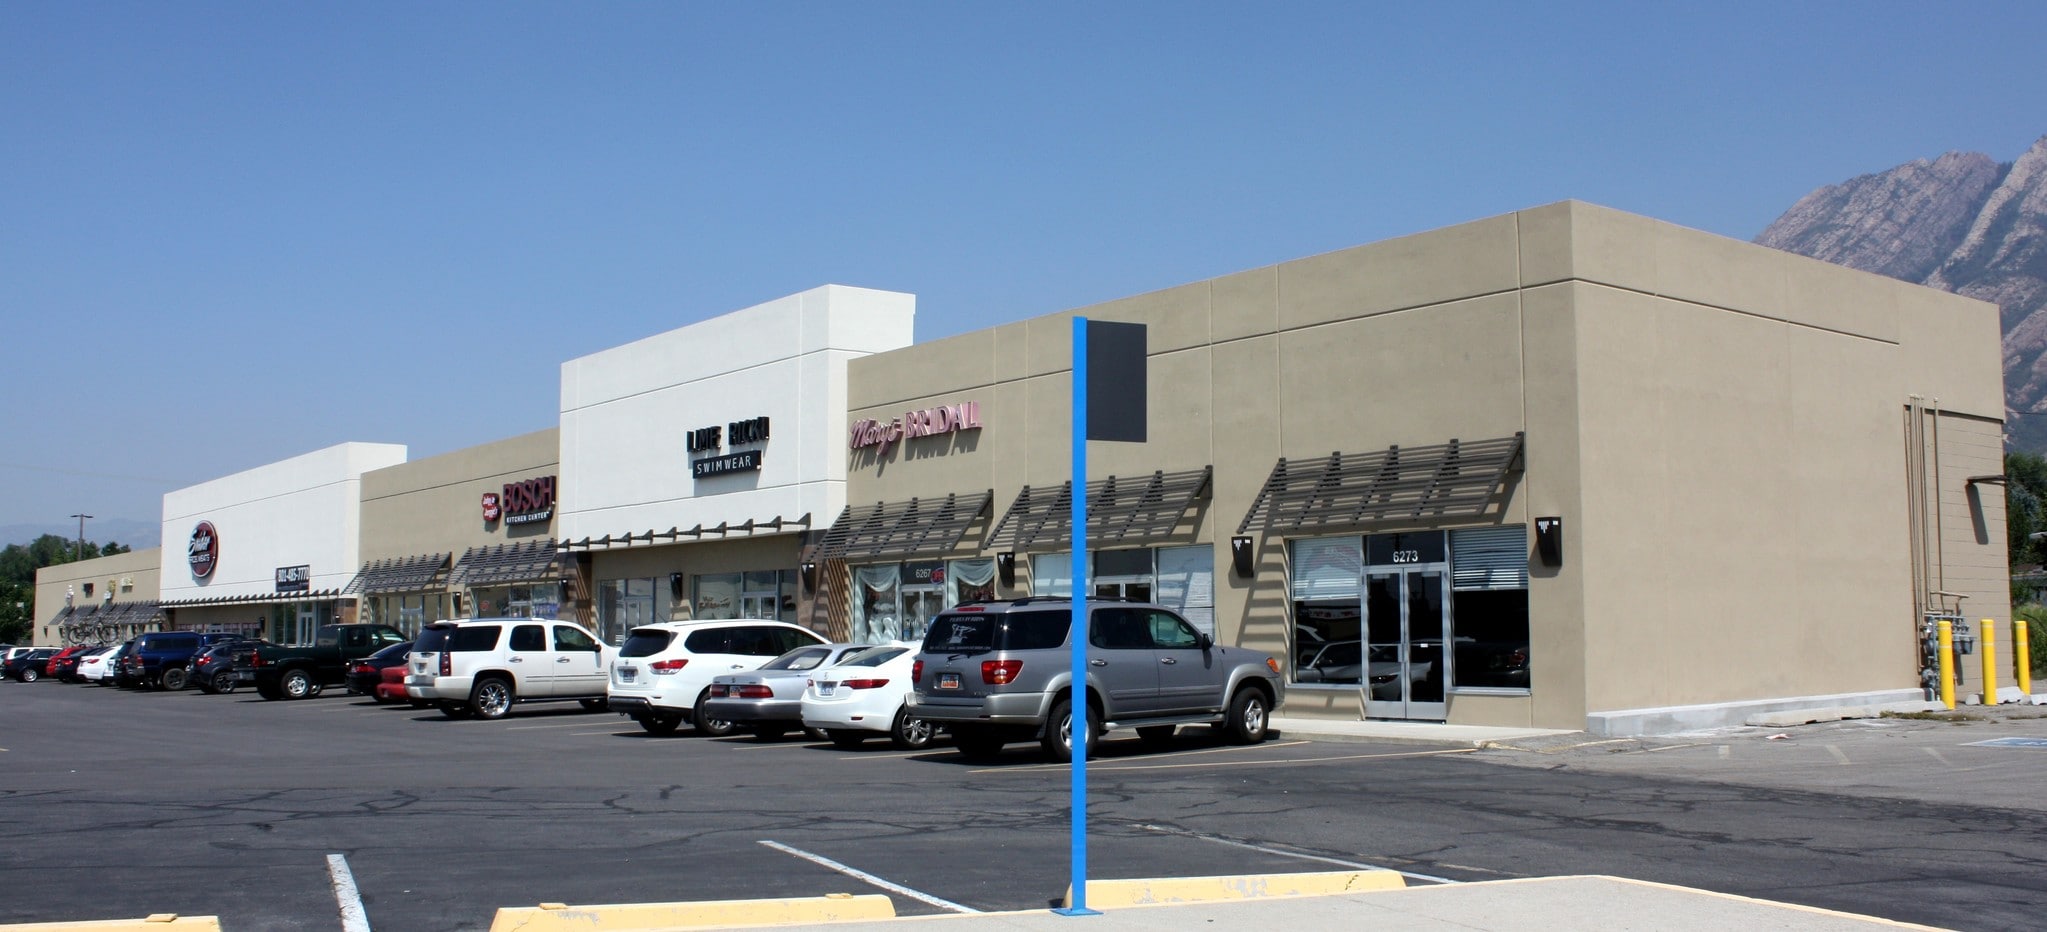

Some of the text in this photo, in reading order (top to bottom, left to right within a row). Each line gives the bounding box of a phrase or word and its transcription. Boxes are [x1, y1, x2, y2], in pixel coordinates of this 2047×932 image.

[849, 400, 983, 455] Mary's BRIDAL
[697, 455, 751, 474] SWIMWEAR
[503, 476, 556, 512] BOSCH
[506, 511, 547, 524] KITCHEN CENTER
[1393, 550, 1418, 563] 6273
[916, 569, 931, 579] 6267
